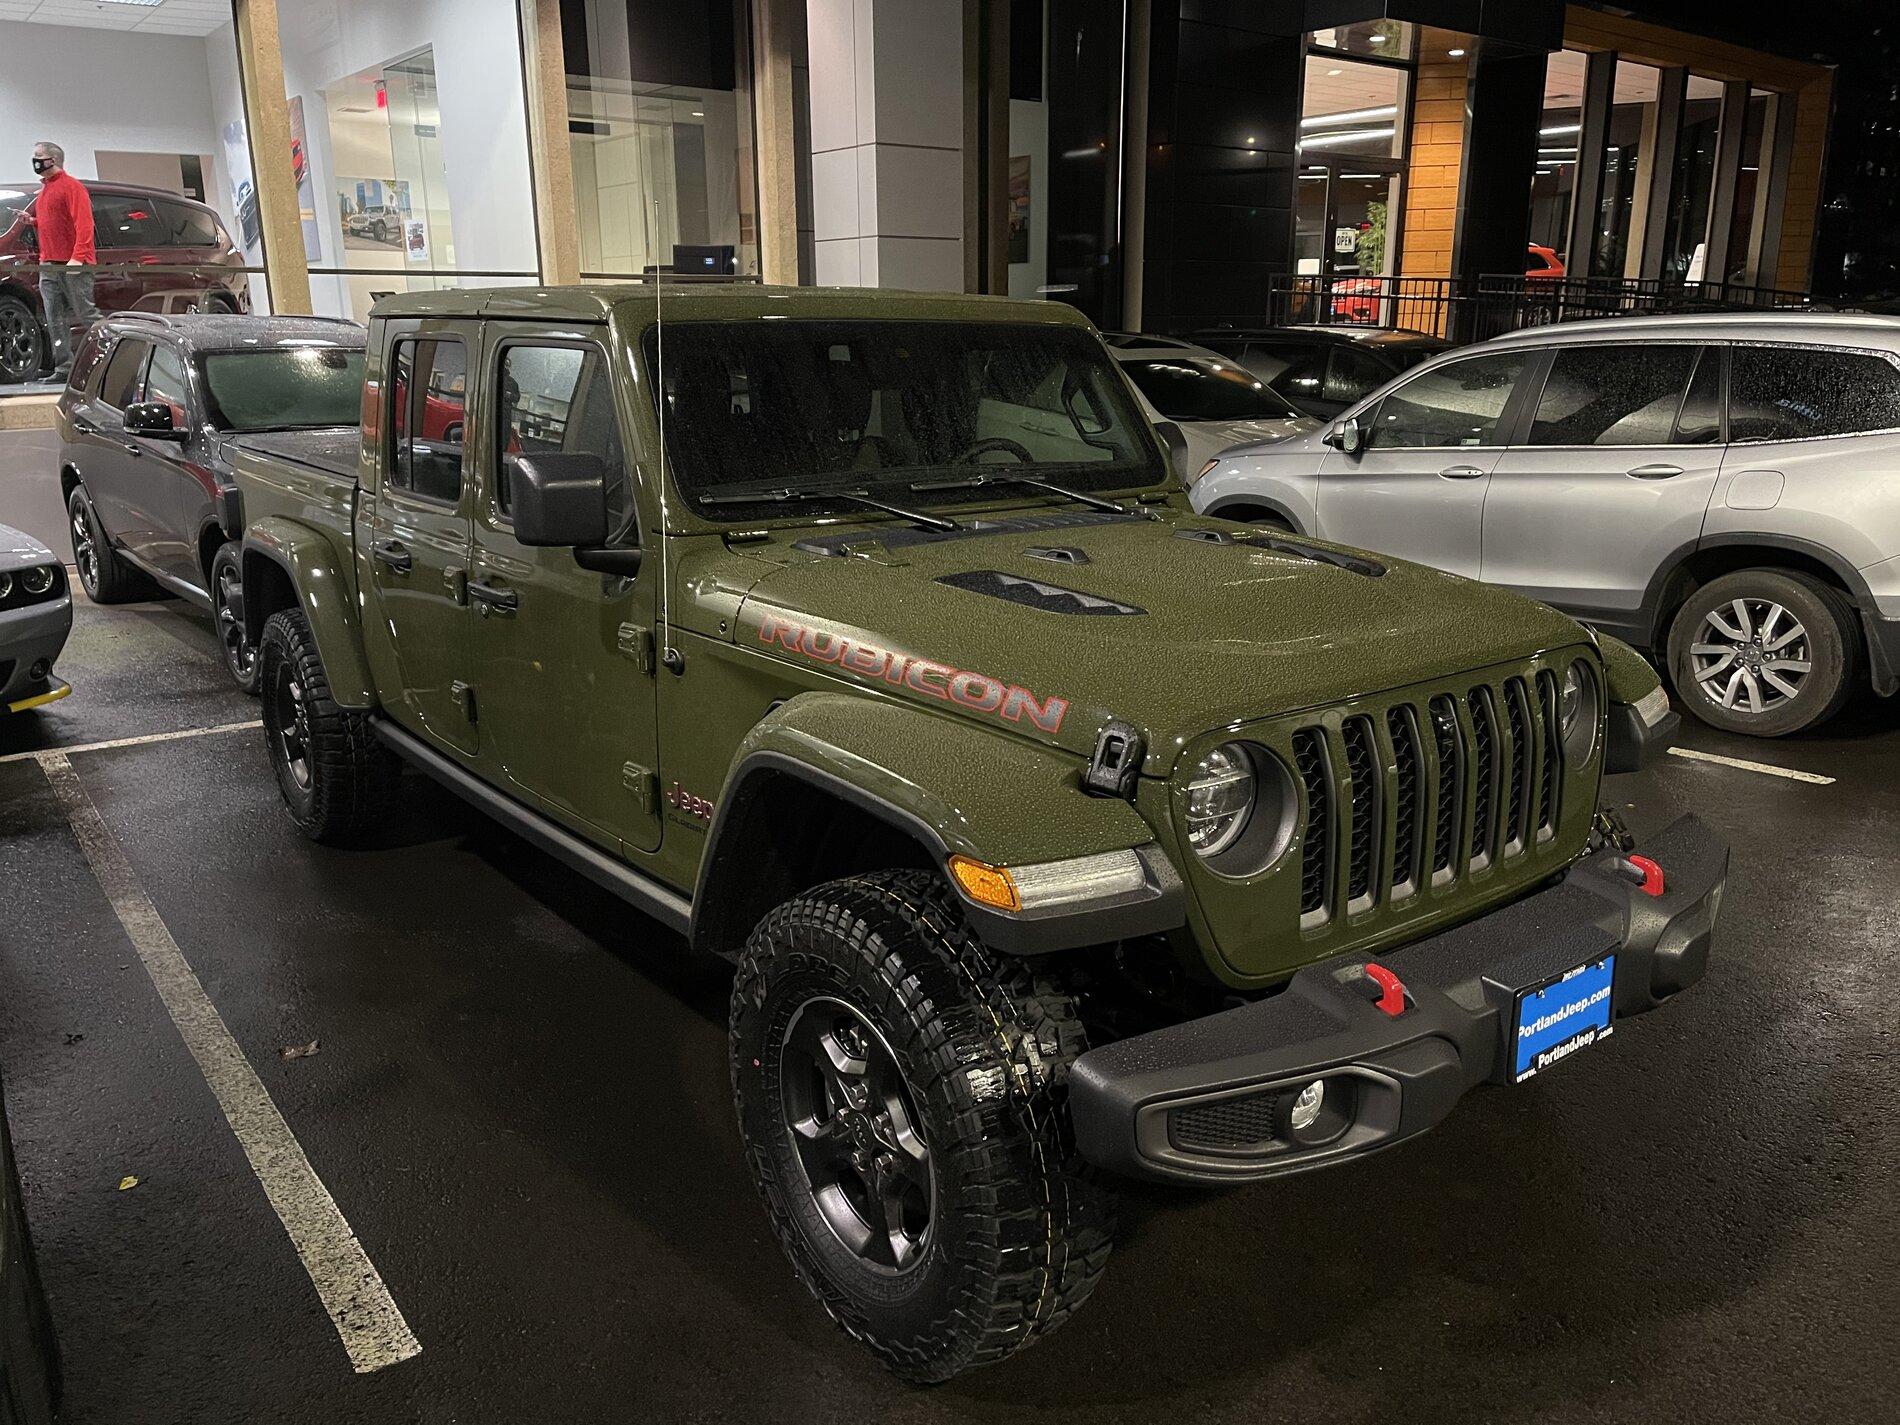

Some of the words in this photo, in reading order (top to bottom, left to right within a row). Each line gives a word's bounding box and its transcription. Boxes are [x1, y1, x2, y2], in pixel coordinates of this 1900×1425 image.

[1336, 235, 1352, 246] OPEN
[758, 614, 1069, 734] RUBICON
[666, 781, 714, 826] Jeep
[1518, 985, 1611, 1038] PortlandJeep.com
[1516, 1066, 1537, 1083] www.
[1538, 1029, 1595, 1069] PortlandJeep
